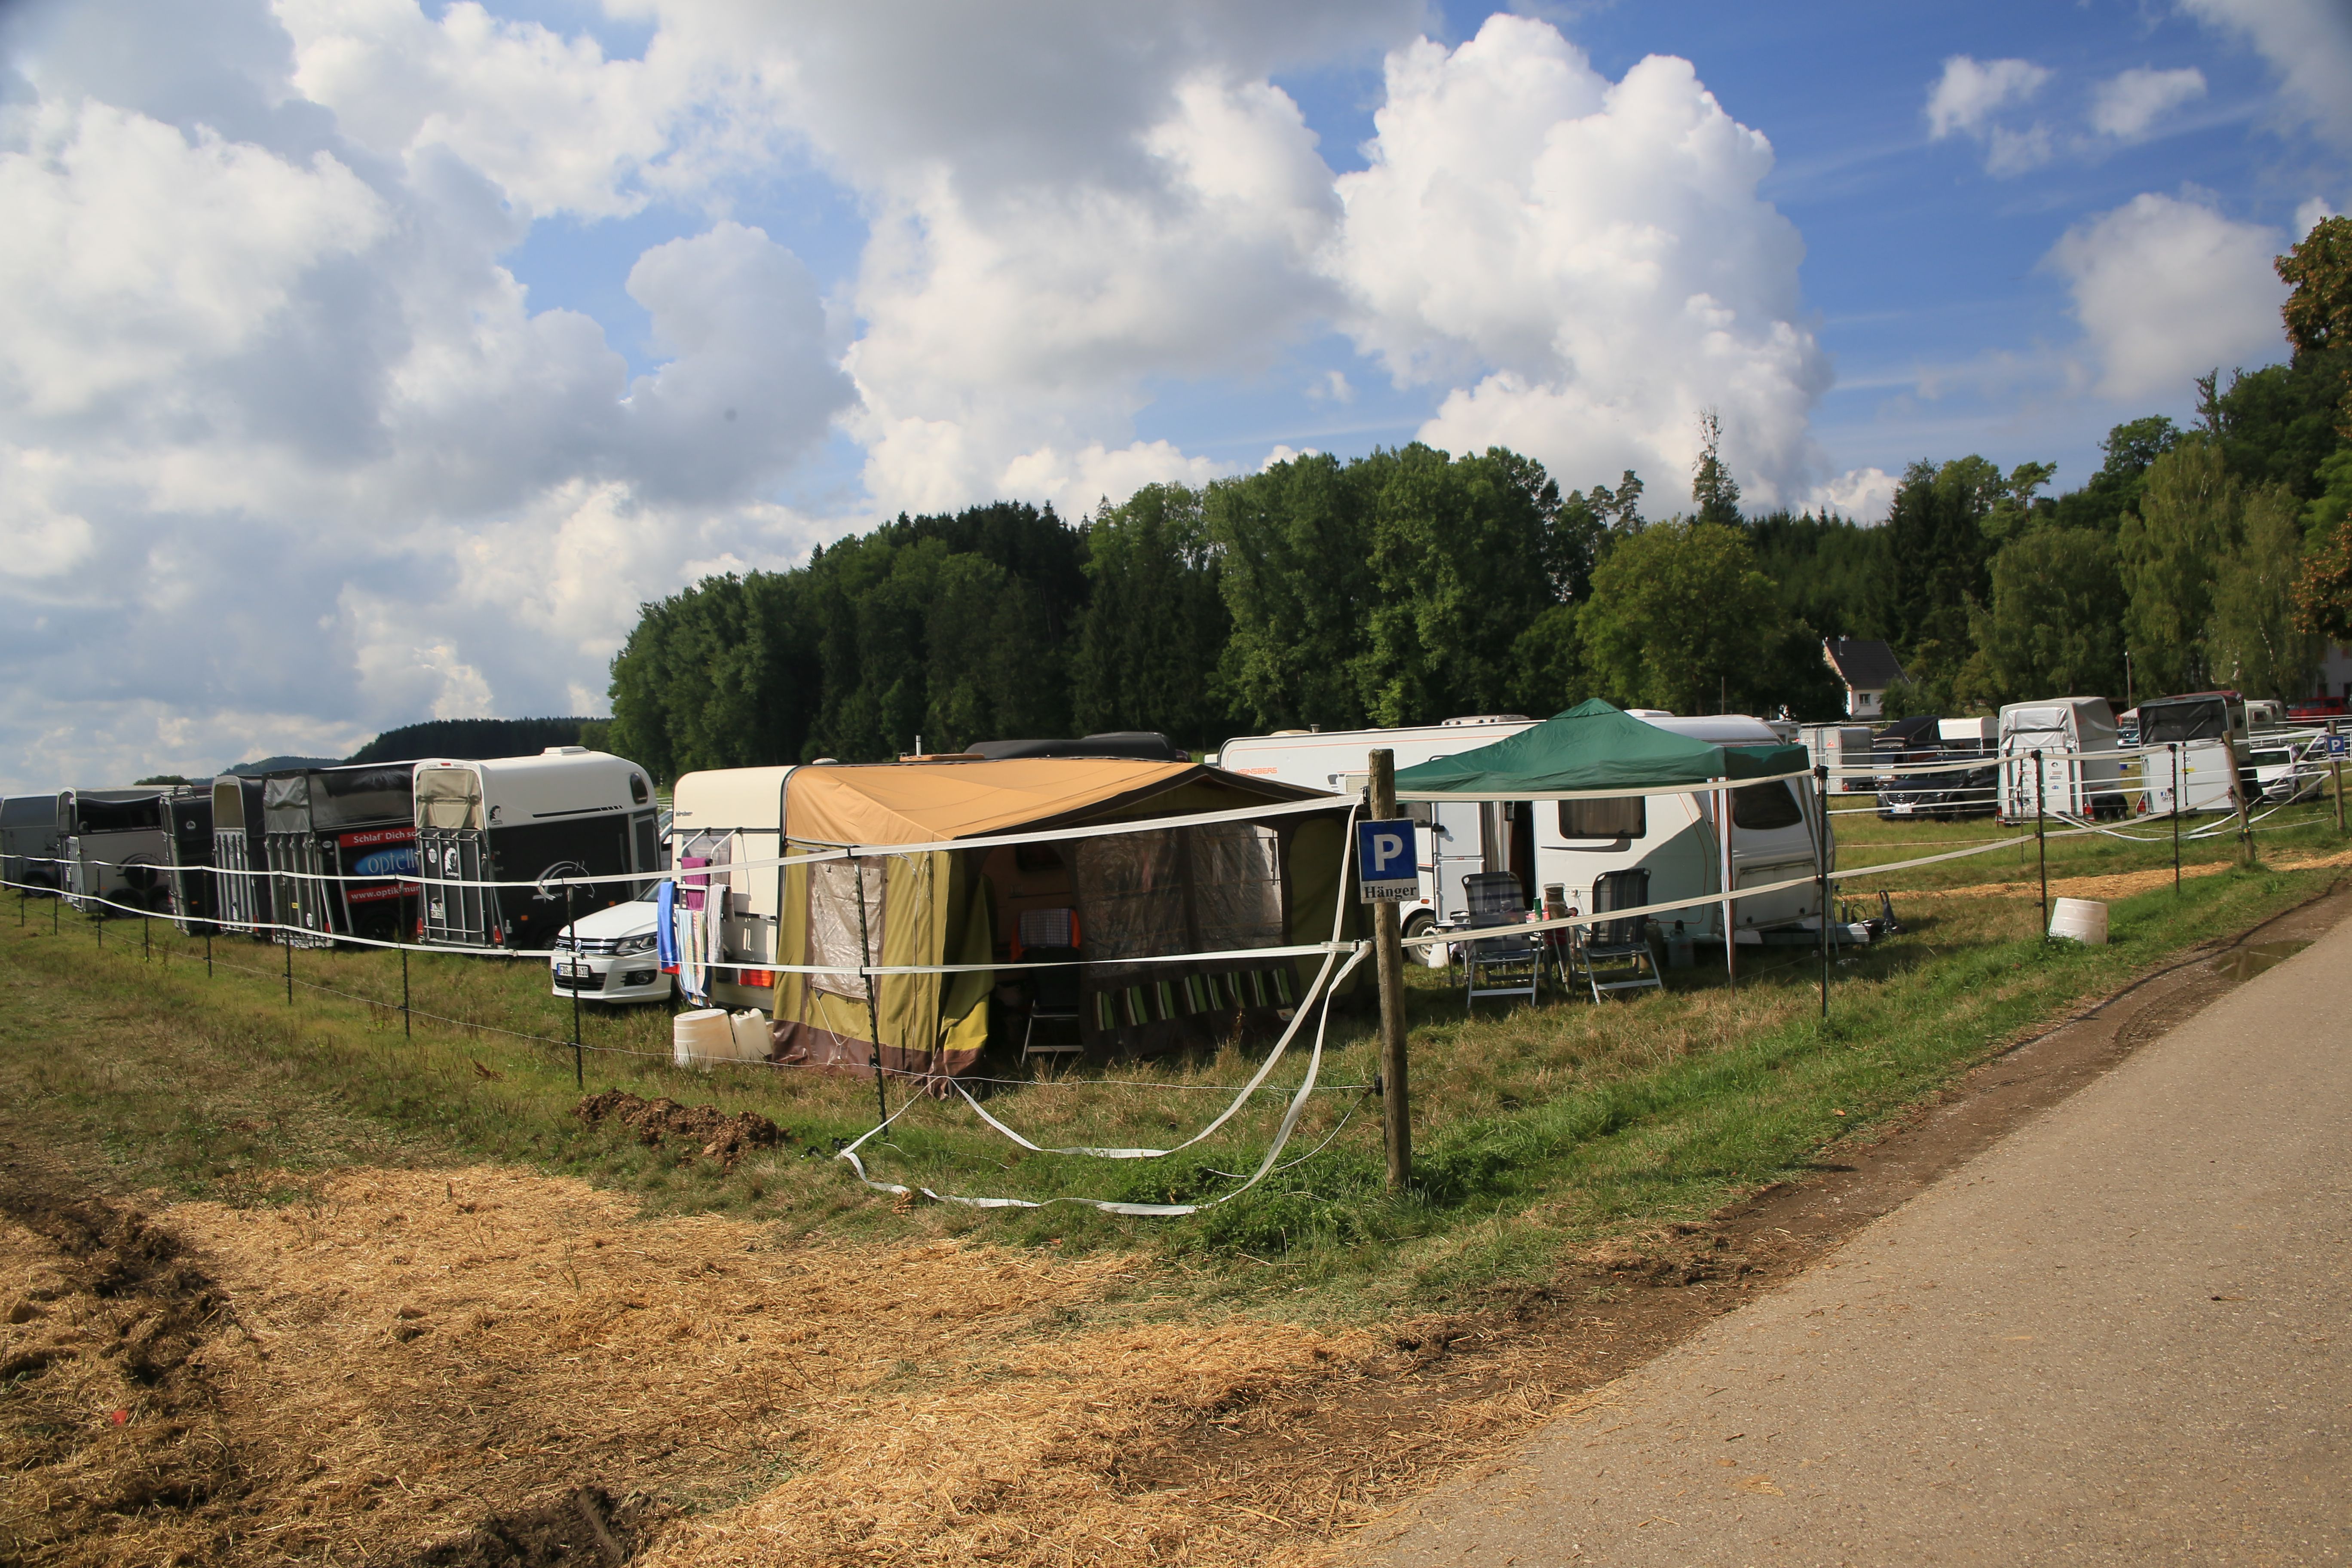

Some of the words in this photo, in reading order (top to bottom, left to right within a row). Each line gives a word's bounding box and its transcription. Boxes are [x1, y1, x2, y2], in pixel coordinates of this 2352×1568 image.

[2331, 740, 2340, 750] P
[386, 831, 404, 839] Dich
[1374, 834, 1403, 871] P
[1364, 886, 1417, 900] Hänger
